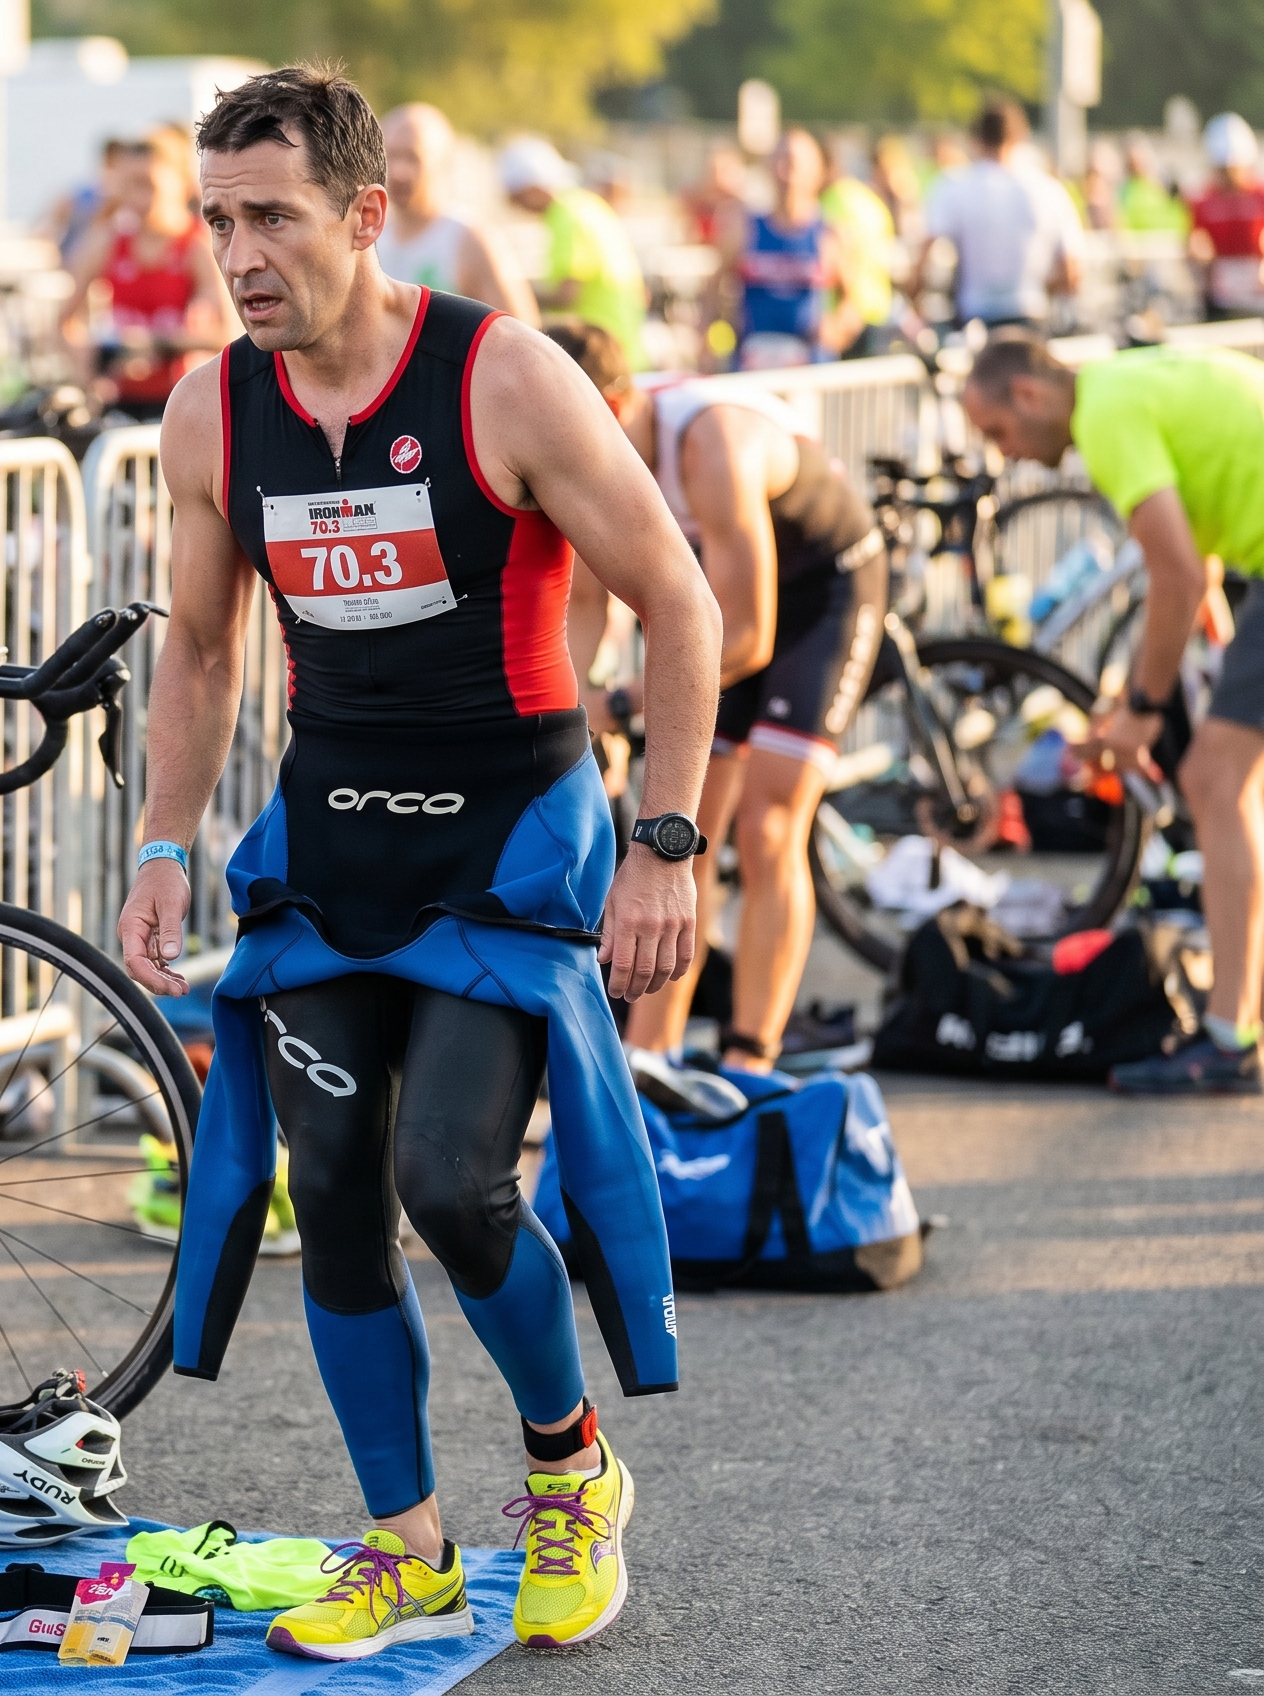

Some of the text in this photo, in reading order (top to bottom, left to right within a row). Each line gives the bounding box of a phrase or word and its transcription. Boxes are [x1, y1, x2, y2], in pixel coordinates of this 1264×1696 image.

[309, 499, 376, 519] IRONMAN
[310, 520, 340, 534] 70.3
[300, 541, 403, 590] 70.3
[328, 788, 465, 814] orca
[13, 1469, 76, 1505] RUDY
